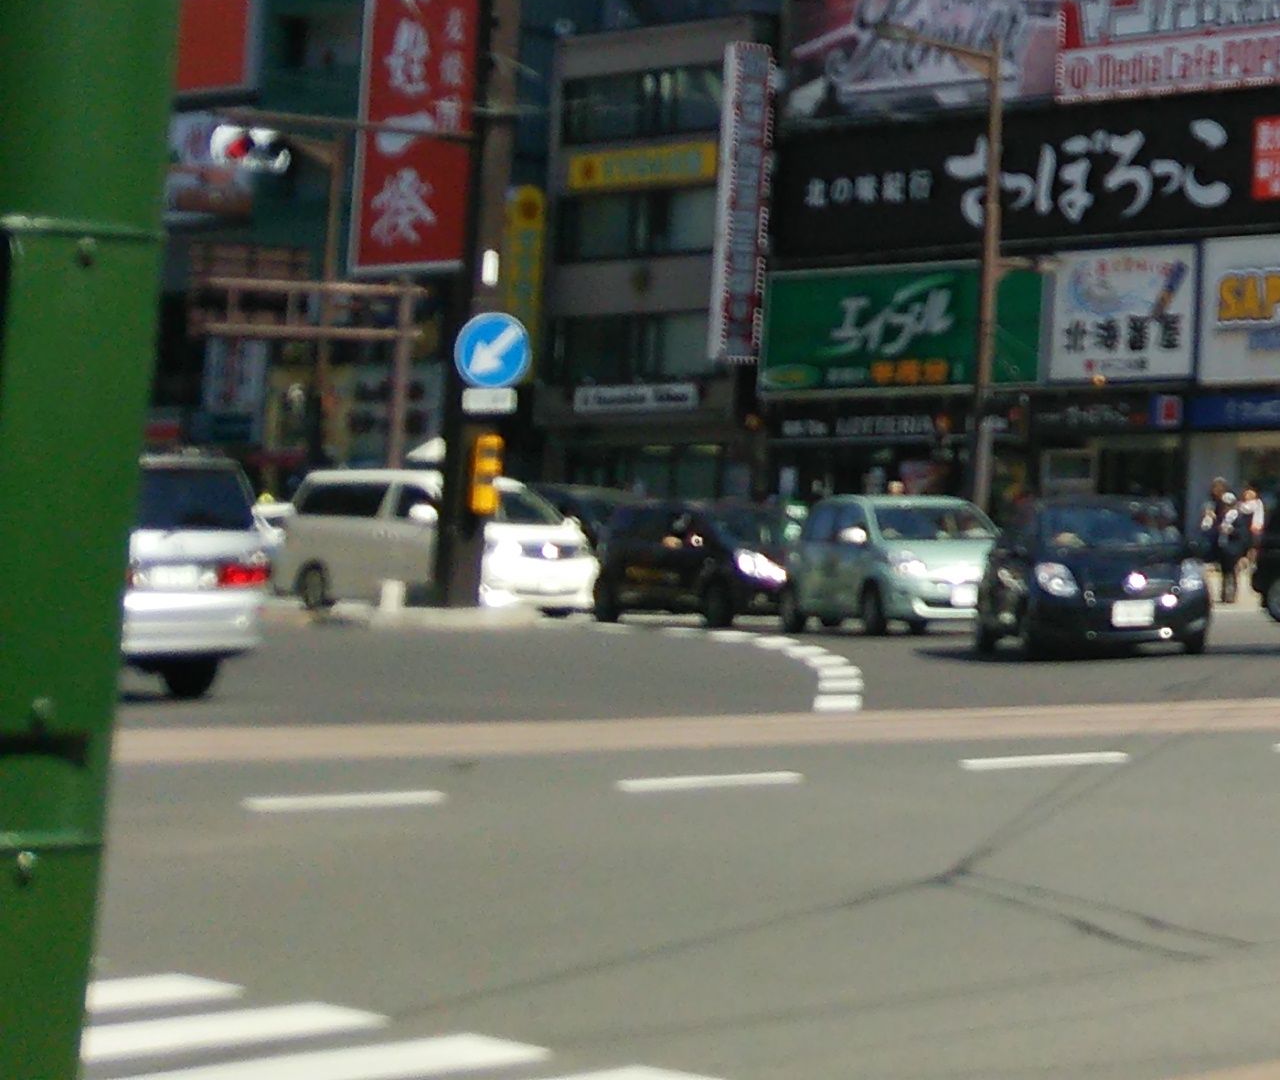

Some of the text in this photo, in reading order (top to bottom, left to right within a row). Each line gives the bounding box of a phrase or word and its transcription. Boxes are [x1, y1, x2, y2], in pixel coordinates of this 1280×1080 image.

[944, 117, 1231, 229] さっぽろっこ
